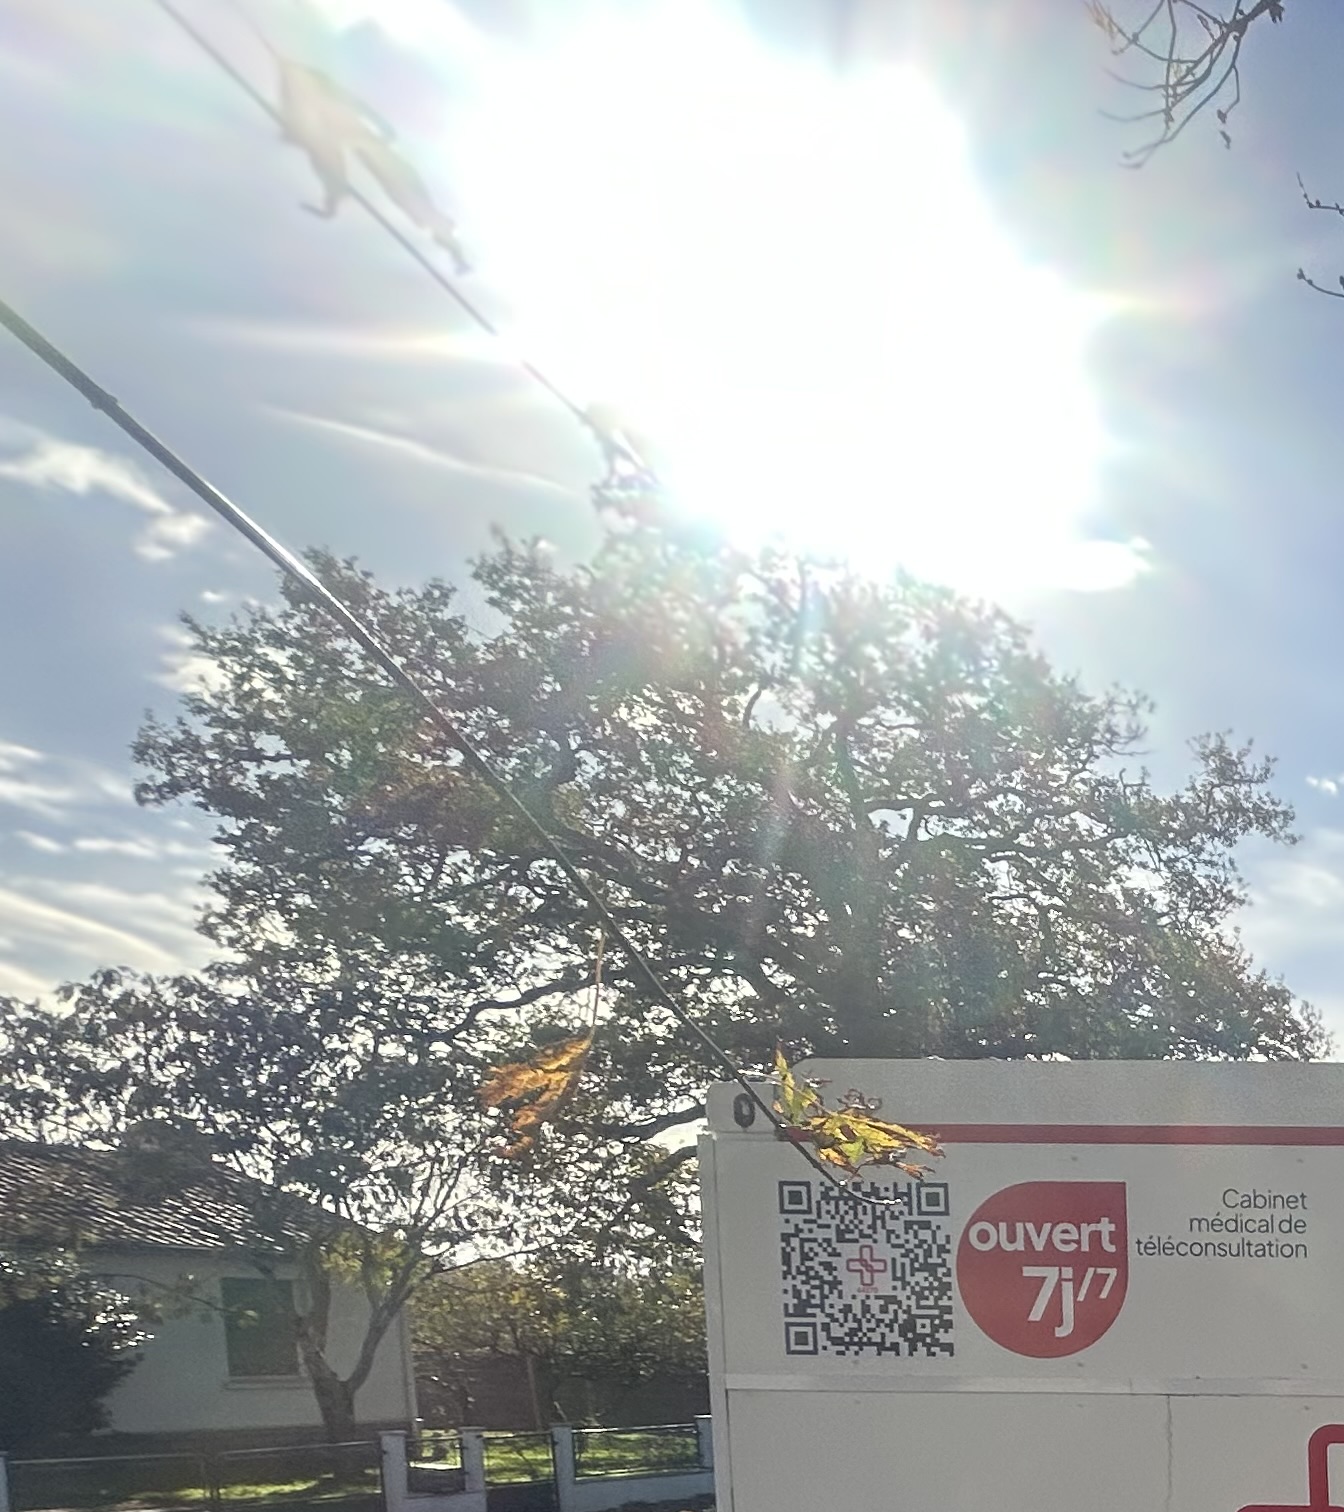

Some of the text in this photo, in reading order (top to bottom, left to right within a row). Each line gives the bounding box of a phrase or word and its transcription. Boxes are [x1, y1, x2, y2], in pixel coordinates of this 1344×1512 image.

[1222, 1188, 1308, 1210] Cabinet
[968, 1216, 1117, 1252] ouvert
[1188, 1211, 1308, 1235] médical de
[1135, 1236, 1309, 1259] téléconsultation
[1021, 1266, 1119, 1337] 7j/7
